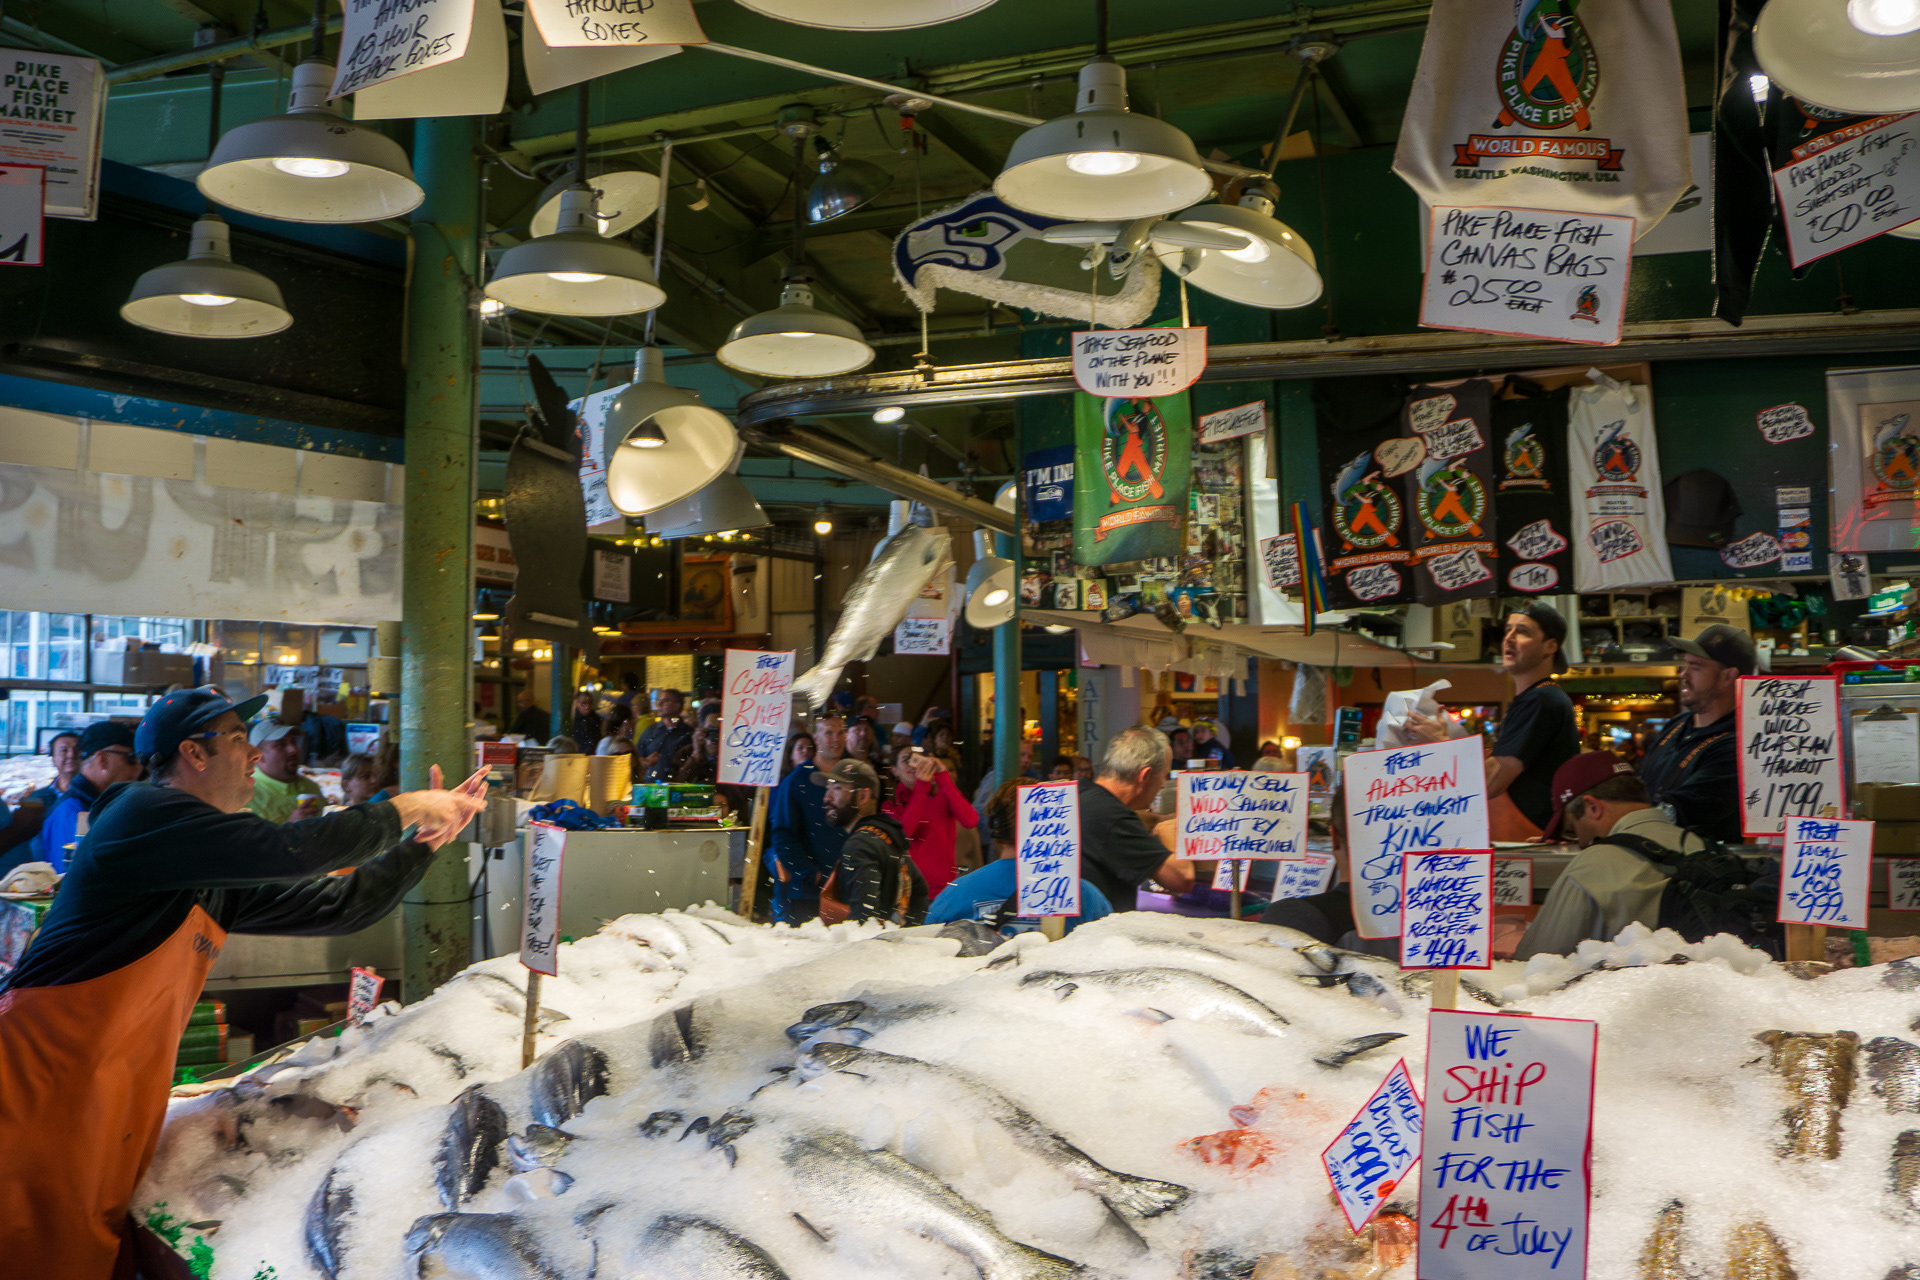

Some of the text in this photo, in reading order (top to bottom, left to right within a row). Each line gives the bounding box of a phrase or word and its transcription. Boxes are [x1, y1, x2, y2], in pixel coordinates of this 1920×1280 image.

[378, 14, 429, 51] HOUR
[582, 16, 648, 42] BOXES
[405, 33, 455, 68] BOXES
[1502, 40, 1523, 82] PIKE
[16, 61, 61, 79] PIKE
[5, 75, 69, 94] PLACE
[14, 90, 58, 108] FISH
[1503, 84, 1542, 123] PLACE
[1548, 97, 1583, 123] FISH
[1472, 138, 1607, 157] WORLD FAMOUS
[1595, 172, 1620, 183] USA
[1442, 208, 1613, 246] PIKE PLACE FISH
[1440, 239, 1615, 277] CANVAS BAGS
[1077, 332, 1179, 355] TAKE SEAFOOD
[1088, 352, 1180, 369] ON THE PLANE
[1095, 373, 1128, 389] WITH
[1104, 416, 1165, 497] PIKE PLACE FISH MARKET
[1027, 467, 1051, 487] I'M
[1102, 507, 1175, 527] WORLD FAMOUS
[1418, 492, 1429, 516] PIKE
[1425, 517, 1451, 535] PLACE
[1469, 480, 1486, 521] MARKET
[1335, 506, 1346, 528] PIKE
[1342, 529, 1369, 546] PLACE
[1384, 492, 1400, 532] MARKET
[1334, 552, 1410, 568] WORLD FAMOUS
[1416, 543, 1493, 556] WORLD FAMOUS
[1786, 557, 1811, 567] VISA
[730, 669, 792, 697] COPPER
[1752, 679, 1816, 701] FRESH
[732, 698, 788, 730] RIVER
[1760, 700, 1822, 716] WHOLE
[1084, 679, 1100, 761] ATRI
[1764, 716, 1810, 734] WILD
[1746, 730, 1836, 759] ALASKAN
[1384, 750, 1435, 774] FRESH
[1761, 755, 1835, 778] HALIBUT
[1190, 774, 1297, 793] WE ONLY SELL
[1366, 755, 1458, 802] ALASKAN
[1024, 785, 1067, 806] FRESH
[1191, 792, 1297, 815] WILD SALMON
[1029, 805, 1072, 822] WHOLE
[1030, 823, 1070, 838] LOCAL
[1185, 816, 1280, 835] CAUGHT BY
[1798, 821, 1850, 841] FRESH
[1185, 832, 1301, 856] WILD FISHERMEN
[1379, 819, 1445, 857] KING
[1414, 852, 1478, 873] FRESH
[1798, 844, 1848, 859] LOCAL
[1791, 858, 1841, 880] LING
[1417, 875, 1486, 893] WHOLE
[1802, 876, 1840, 893] COD
[1407, 922, 1484, 938] ROCKFISH
[1465, 1024, 1520, 1060] WE
[1389, 1072, 1423, 1133] WHOLE
[1368, 1092, 1412, 1169] OCTOPUS
[1433, 1152, 1572, 1192] FOR THE
[1467, 1234, 1499, 1252] OF
